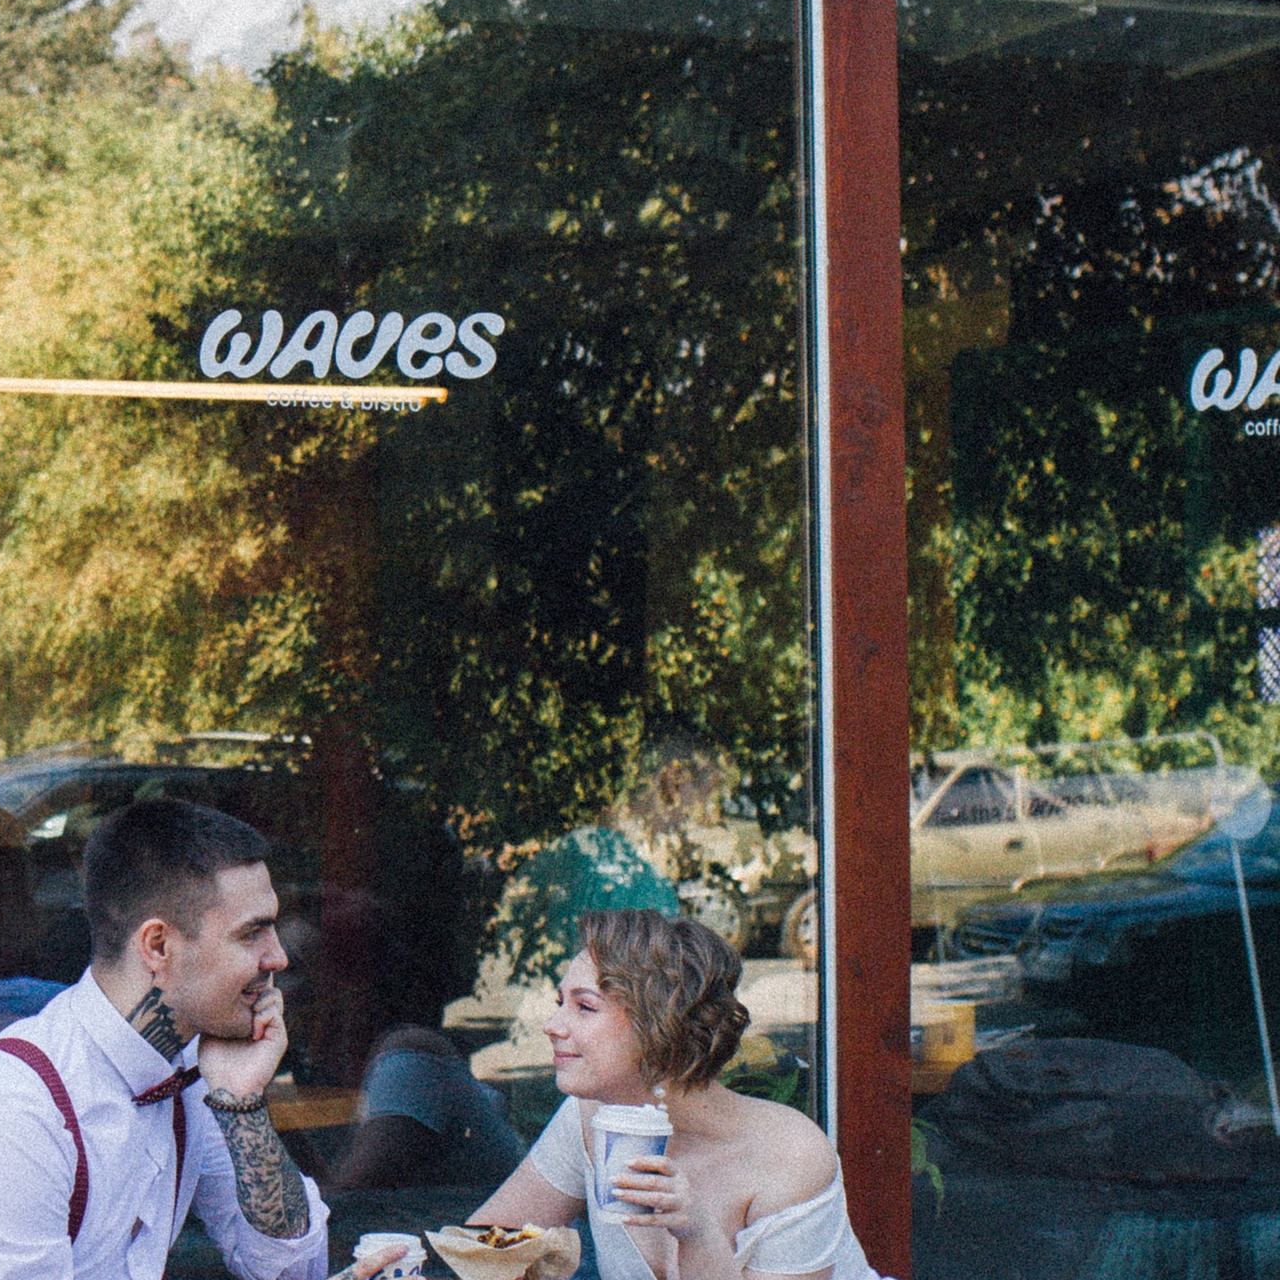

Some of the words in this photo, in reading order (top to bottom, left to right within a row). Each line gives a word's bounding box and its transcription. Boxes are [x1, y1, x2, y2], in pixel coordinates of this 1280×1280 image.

[266, 389, 333, 408] coffee
[340, 391, 354, 410] &
[361, 392, 421, 412] bistro
[1245, 418, 1280, 436] coff
